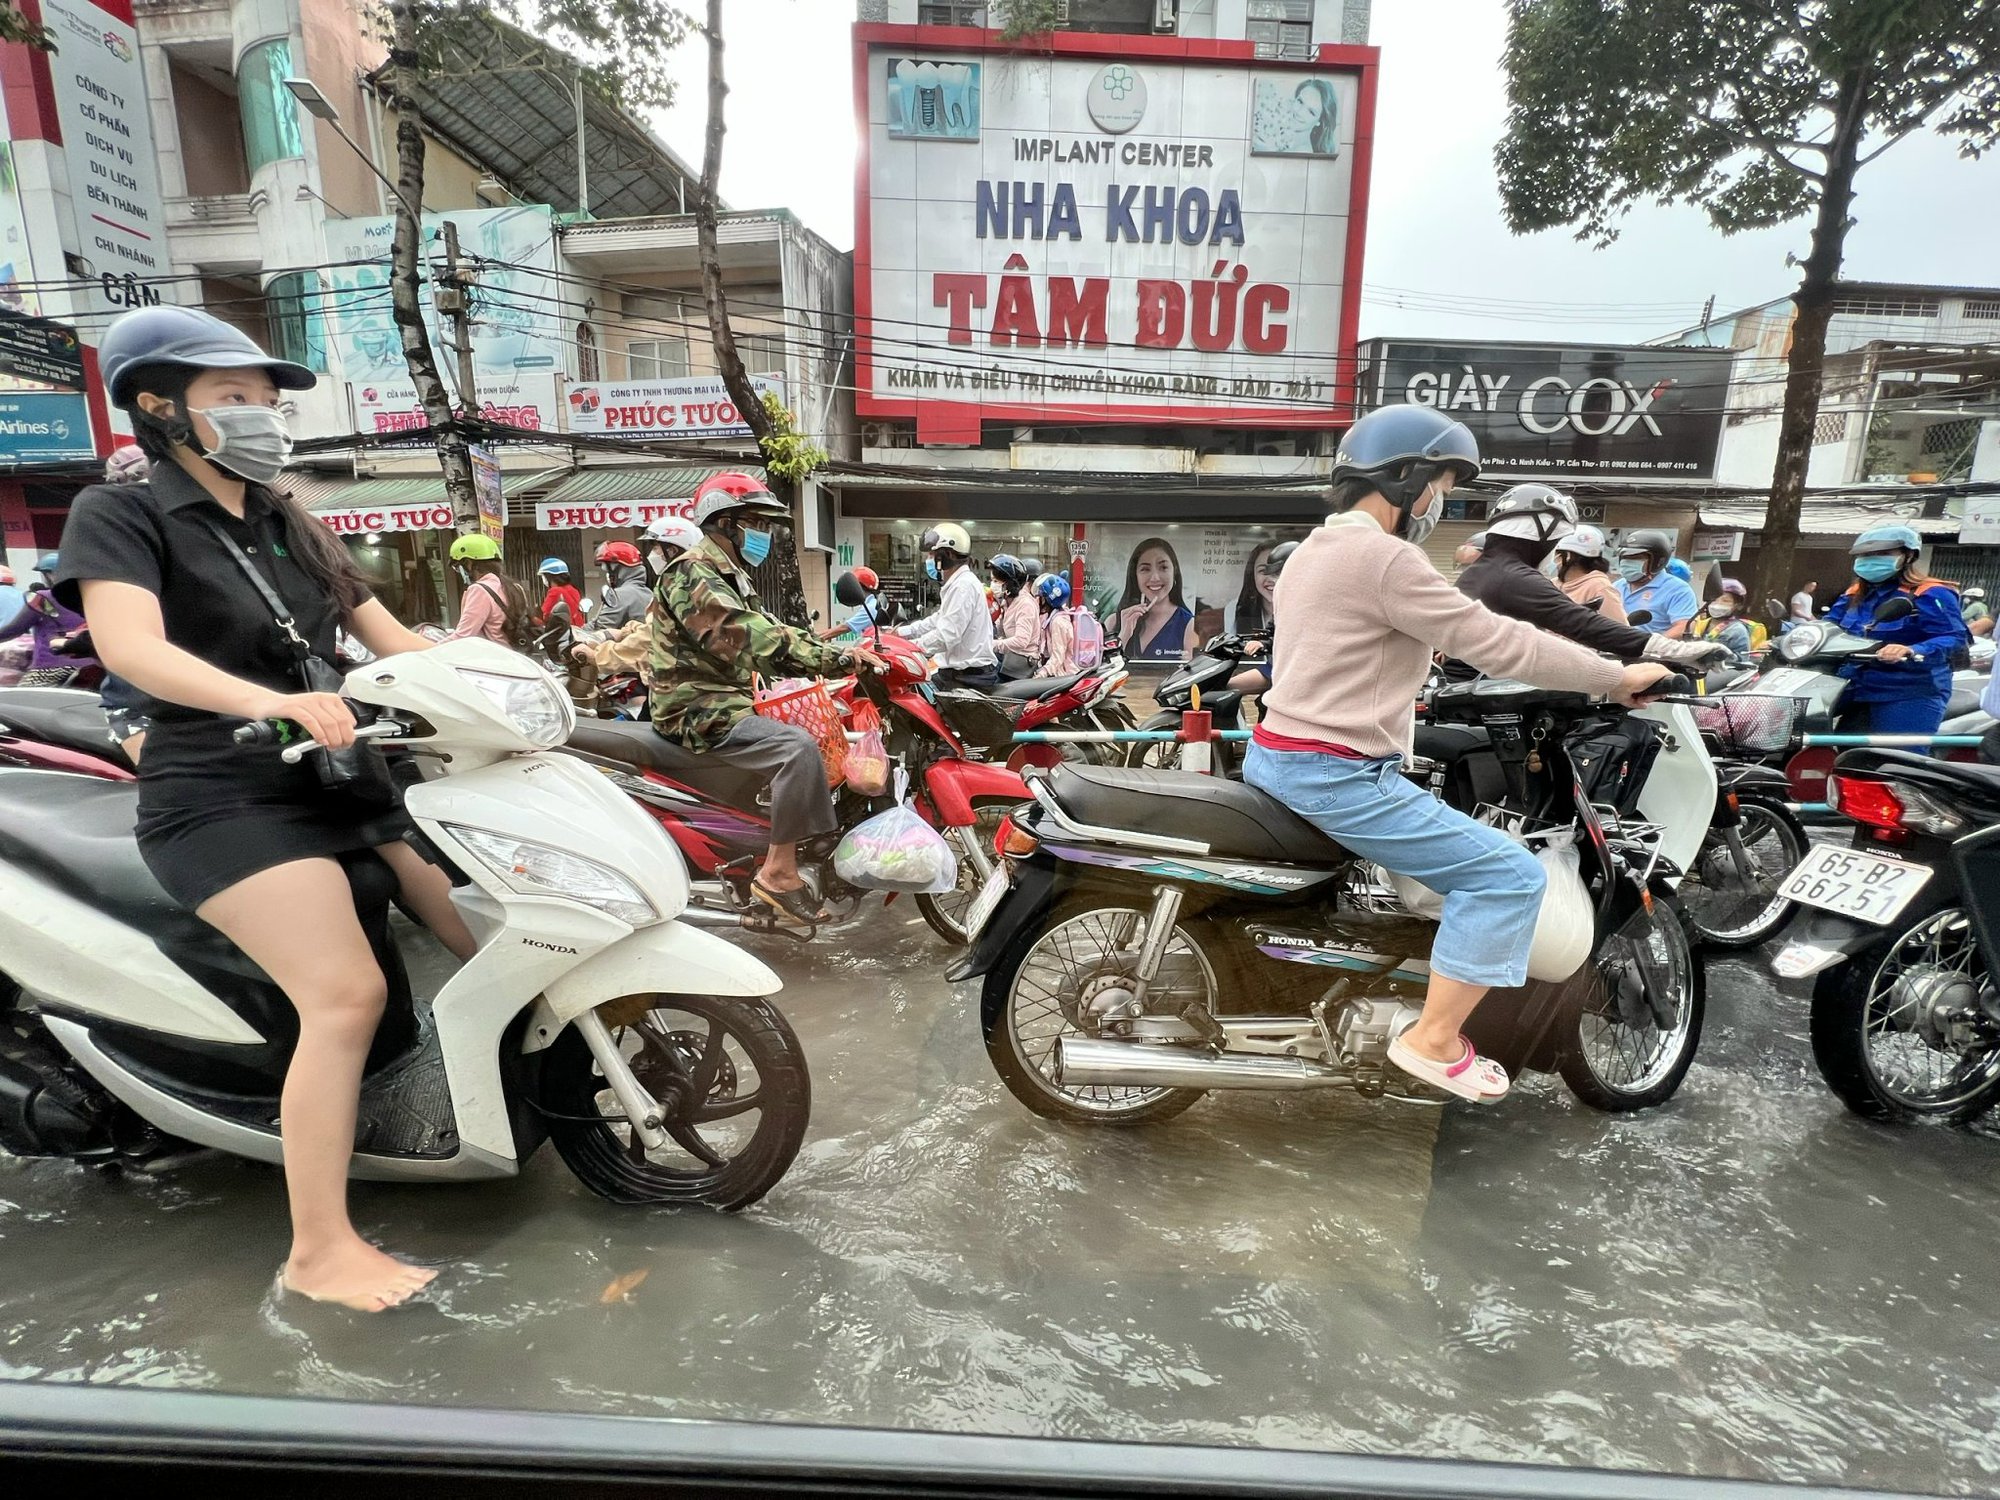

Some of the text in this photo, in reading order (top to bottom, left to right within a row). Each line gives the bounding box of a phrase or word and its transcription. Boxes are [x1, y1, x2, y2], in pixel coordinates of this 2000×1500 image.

[75, 74, 125, 109] CÔNG TY
[85, 131, 133, 166] DỊCH VỤ
[1014, 138, 1213, 168] IMPLANT CENTER
[90, 160, 137, 191] DU LỊCH
[111, 195, 148, 221] THÀNH
[975, 180, 1245, 246] NHA KHOA
[95, 236, 155, 269] CHI NHÁNH
[102, 271, 161, 308] CẦN
[933, 252, 1290, 354] TÂM ĐỨC
[611, 388, 630, 398] CÔNG
[633, 388, 640, 397] TY
[643, 387, 662, 397] TNHH
[711, 384, 720, 394] VÀ
[888, 364, 938, 388] KHÁM
[944, 366, 965, 389] VÀ
[971, 363, 1012, 390] ĐIỀU
[1018, 373, 1045, 396] TRỊ
[1051, 370, 1116, 393] CHUYÊN
[1122, 375, 1166, 393] KHOA
[1173, 373, 1218, 396] RĂNG
[1233, 374, 1271, 397] HÀM
[1286, 375, 1325, 400] MẶT
[604, 397, 747, 428] PHÚC TƯỜ
[1406, 365, 1678, 437] GIÀY COX
[0, 420, 49, 434] Airlines
[374, 404, 430, 433] PHÚ
[1519, 458, 1534, 466] Ninh
[1556, 459, 1566, 467] TP.
[321, 504, 454, 533] HÚC TƯỜ
[547, 503, 630, 527] PHÚC
[1866, 847, 1904, 860] HONDA
[1819, 852, 1906, 891] 65-B2
[1789, 873, 1897, 918] 667.51
[522, 938, 578, 954] HONDA
[1268, 935, 1316, 947] HONDA
